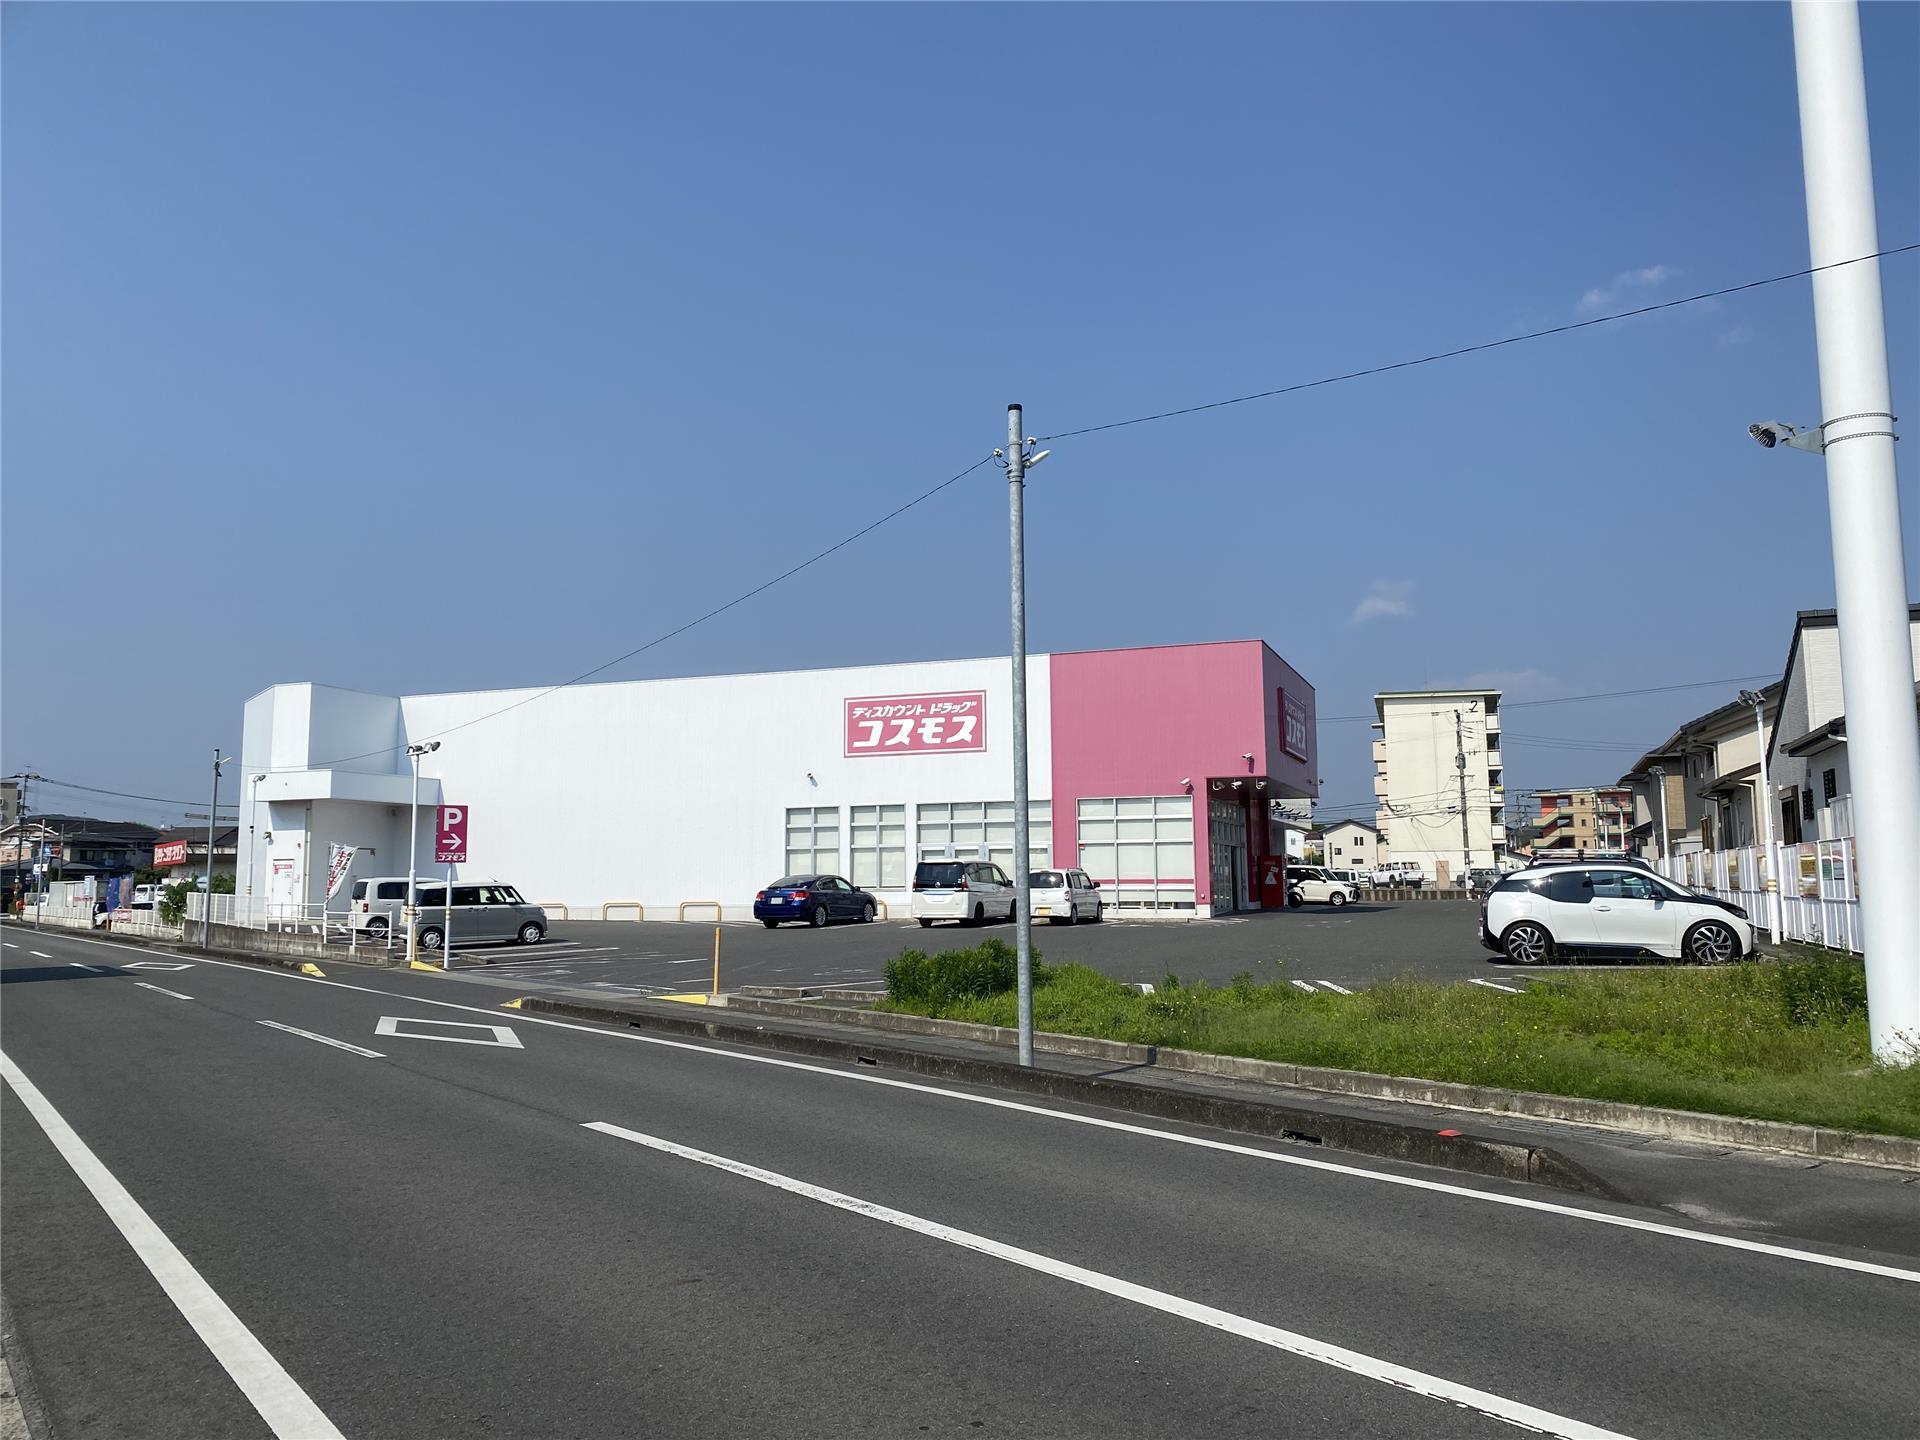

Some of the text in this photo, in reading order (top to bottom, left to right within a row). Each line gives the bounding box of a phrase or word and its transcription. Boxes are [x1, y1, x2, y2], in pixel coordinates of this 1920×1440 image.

[852, 701, 977, 719] ディスカウント ドラッグ
[852, 715, 977, 748] コスモス
[443, 807, 463, 832] P
